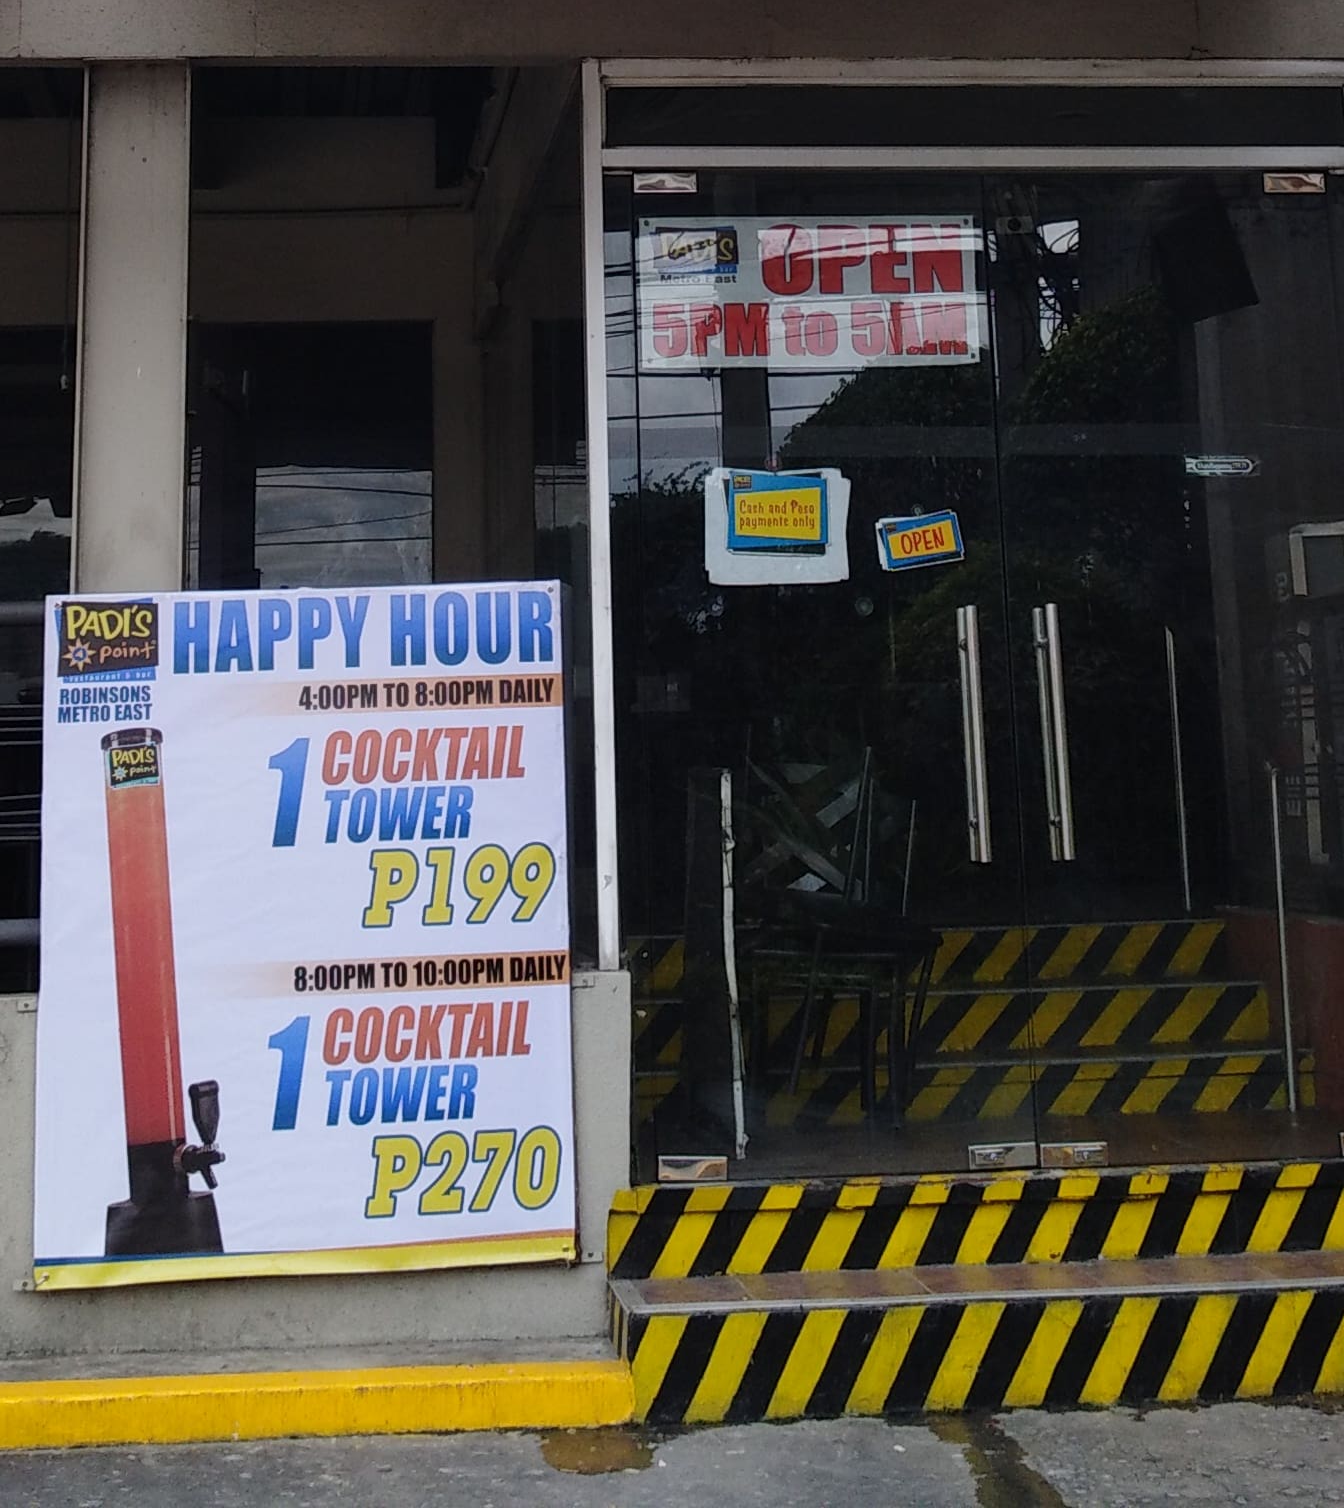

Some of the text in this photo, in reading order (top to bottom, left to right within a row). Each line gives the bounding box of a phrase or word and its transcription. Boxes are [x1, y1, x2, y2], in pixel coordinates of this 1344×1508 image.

[762, 224, 964, 295] OPEN
[652, 301, 969, 357] 5PM to 5AM
[739, 499, 764, 514] Cash
[768, 501, 787, 514] and
[739, 514, 815, 531] payments only
[900, 526, 945, 555] OPEN
[66, 604, 153, 641] PADI'S
[173, 590, 554, 675] HAPPY HOUR
[99, 641, 155, 664] point
[57, 703, 153, 724] METRO EAST
[59, 685, 151, 705] ROBINSONS
[298, 677, 554, 711] 4:00PM TO 8:00PM DAILY
[111, 746, 155, 767] PADI'S
[130, 762, 156, 776] point
[321, 725, 526, 786] COCKTAIL
[268, 737, 311, 848] 1
[324, 785, 474, 845] TOWER
[362, 841, 557, 929] P199
[293, 954, 567, 992] 8:00PM TO 10:00PM DAILY
[322, 1000, 531, 1066] COCKTAIL
[267, 1015, 311, 1131] 1
[325, 1064, 479, 1126] TOWER
[364, 1125, 563, 1219] P270
